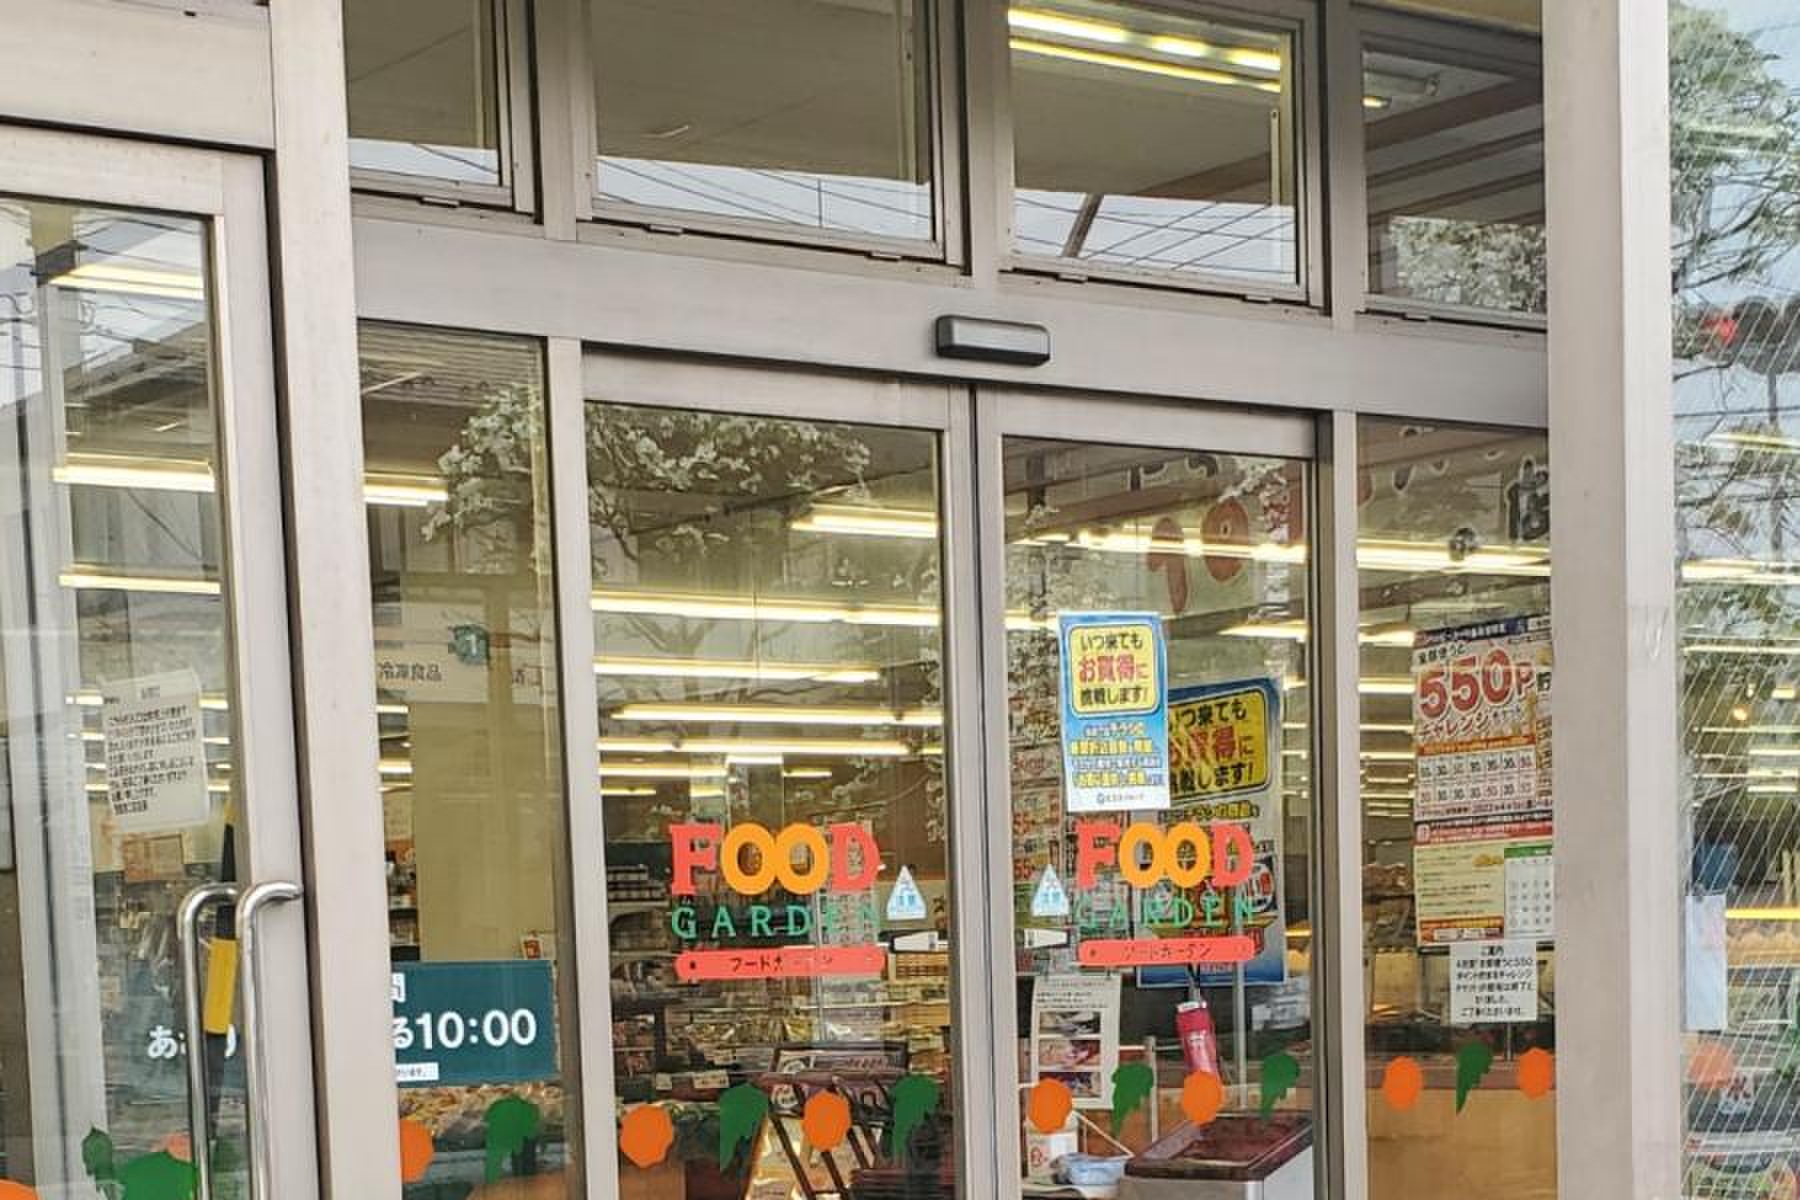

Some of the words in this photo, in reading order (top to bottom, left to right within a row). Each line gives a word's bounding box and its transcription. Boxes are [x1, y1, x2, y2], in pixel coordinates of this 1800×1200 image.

[1080, 631, 1143, 650] いつ来ても
[669, 822, 881, 895] FOOD
[1074, 822, 1255, 890] FOOD
[672, 903, 881, 940] GARDEN
[1075, 892, 1256, 930] GARDEN
